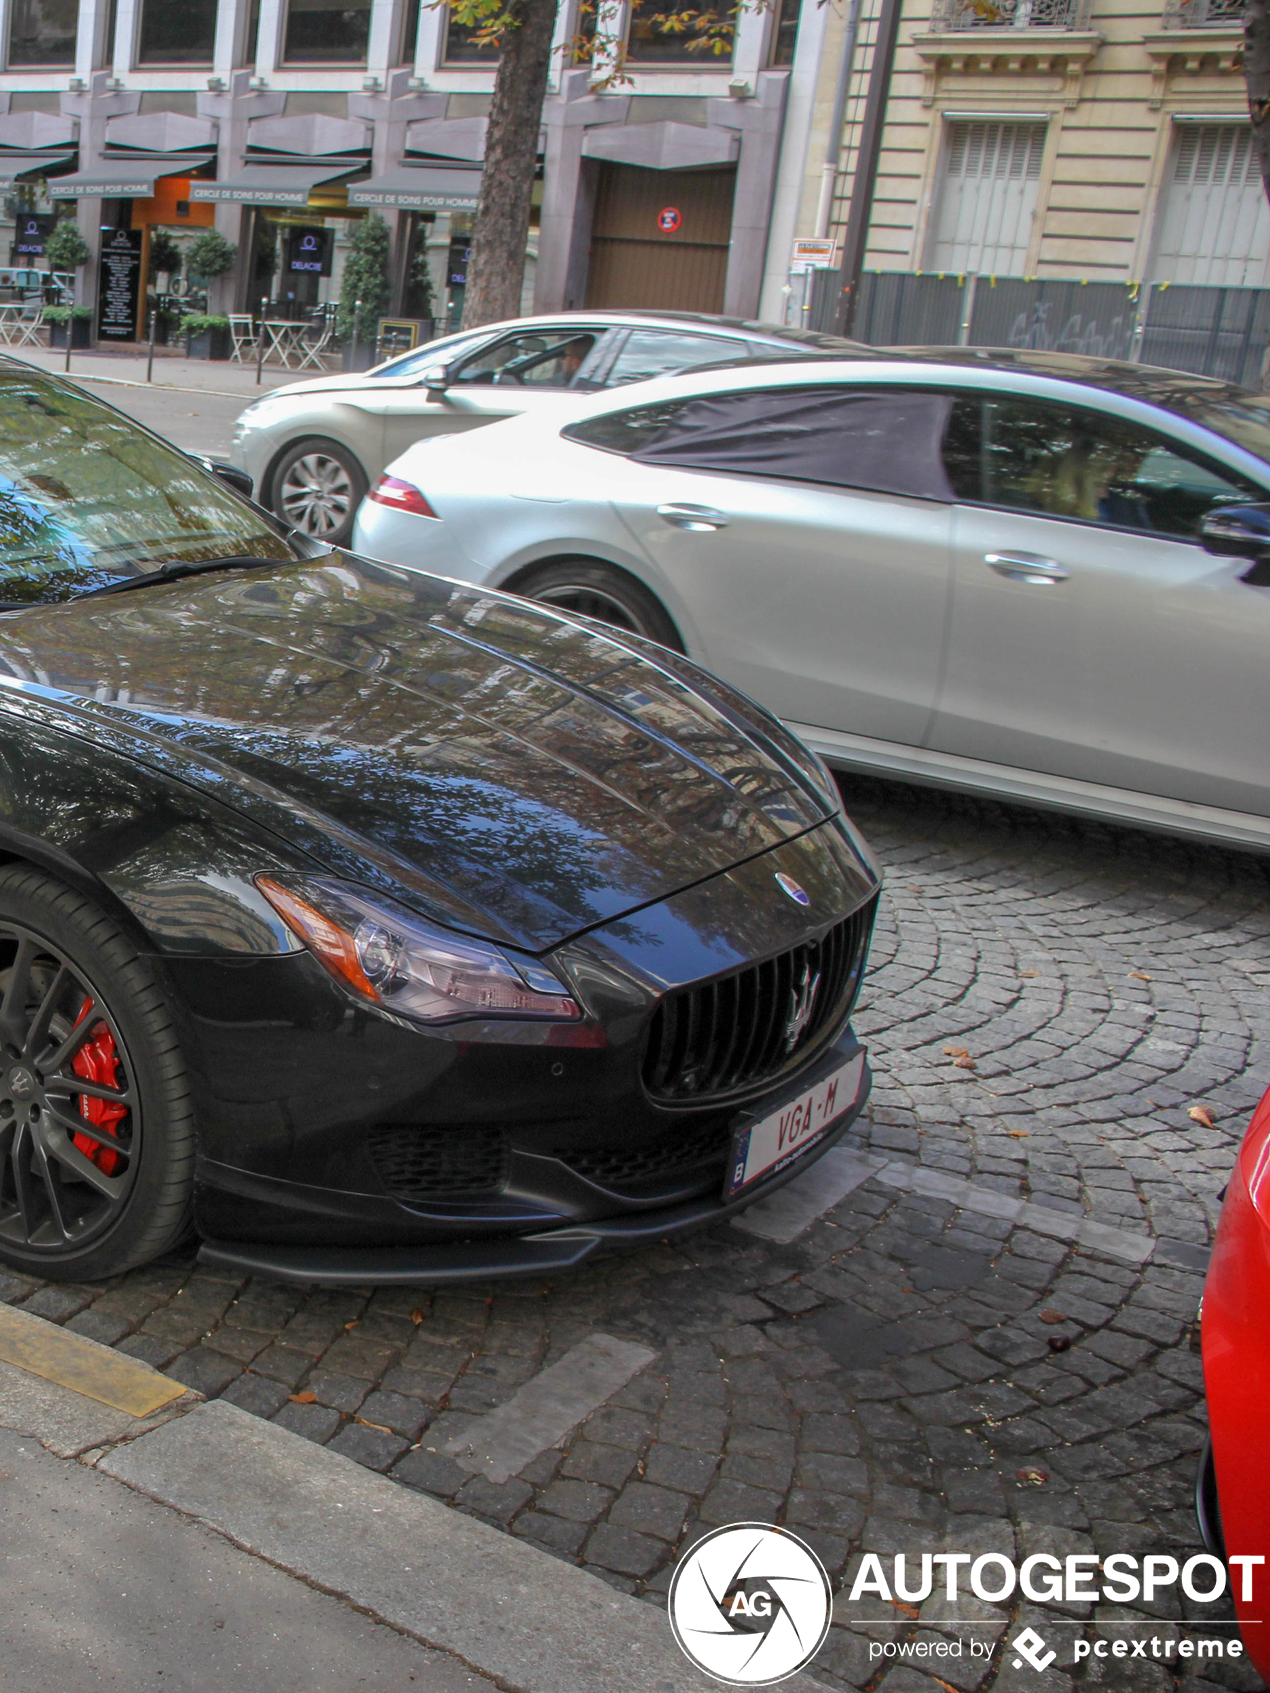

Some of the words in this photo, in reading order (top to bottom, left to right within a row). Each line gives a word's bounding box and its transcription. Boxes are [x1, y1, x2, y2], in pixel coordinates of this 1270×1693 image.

[76, 186, 84, 194] DE
[86, 186, 104, 194] SOINS
[105, 185, 122, 193] POUR
[222, 190, 231, 198] DE
[233, 190, 253, 200] SOINS
[254, 191, 273, 200] POUR
[385, 194, 396, 203] DE
[398, 195, 421, 204] SOINS
[423, 196, 444, 205] POUR
[291, 261, 322, 271] DELACRE
[733, 1162, 745, 1183] B
